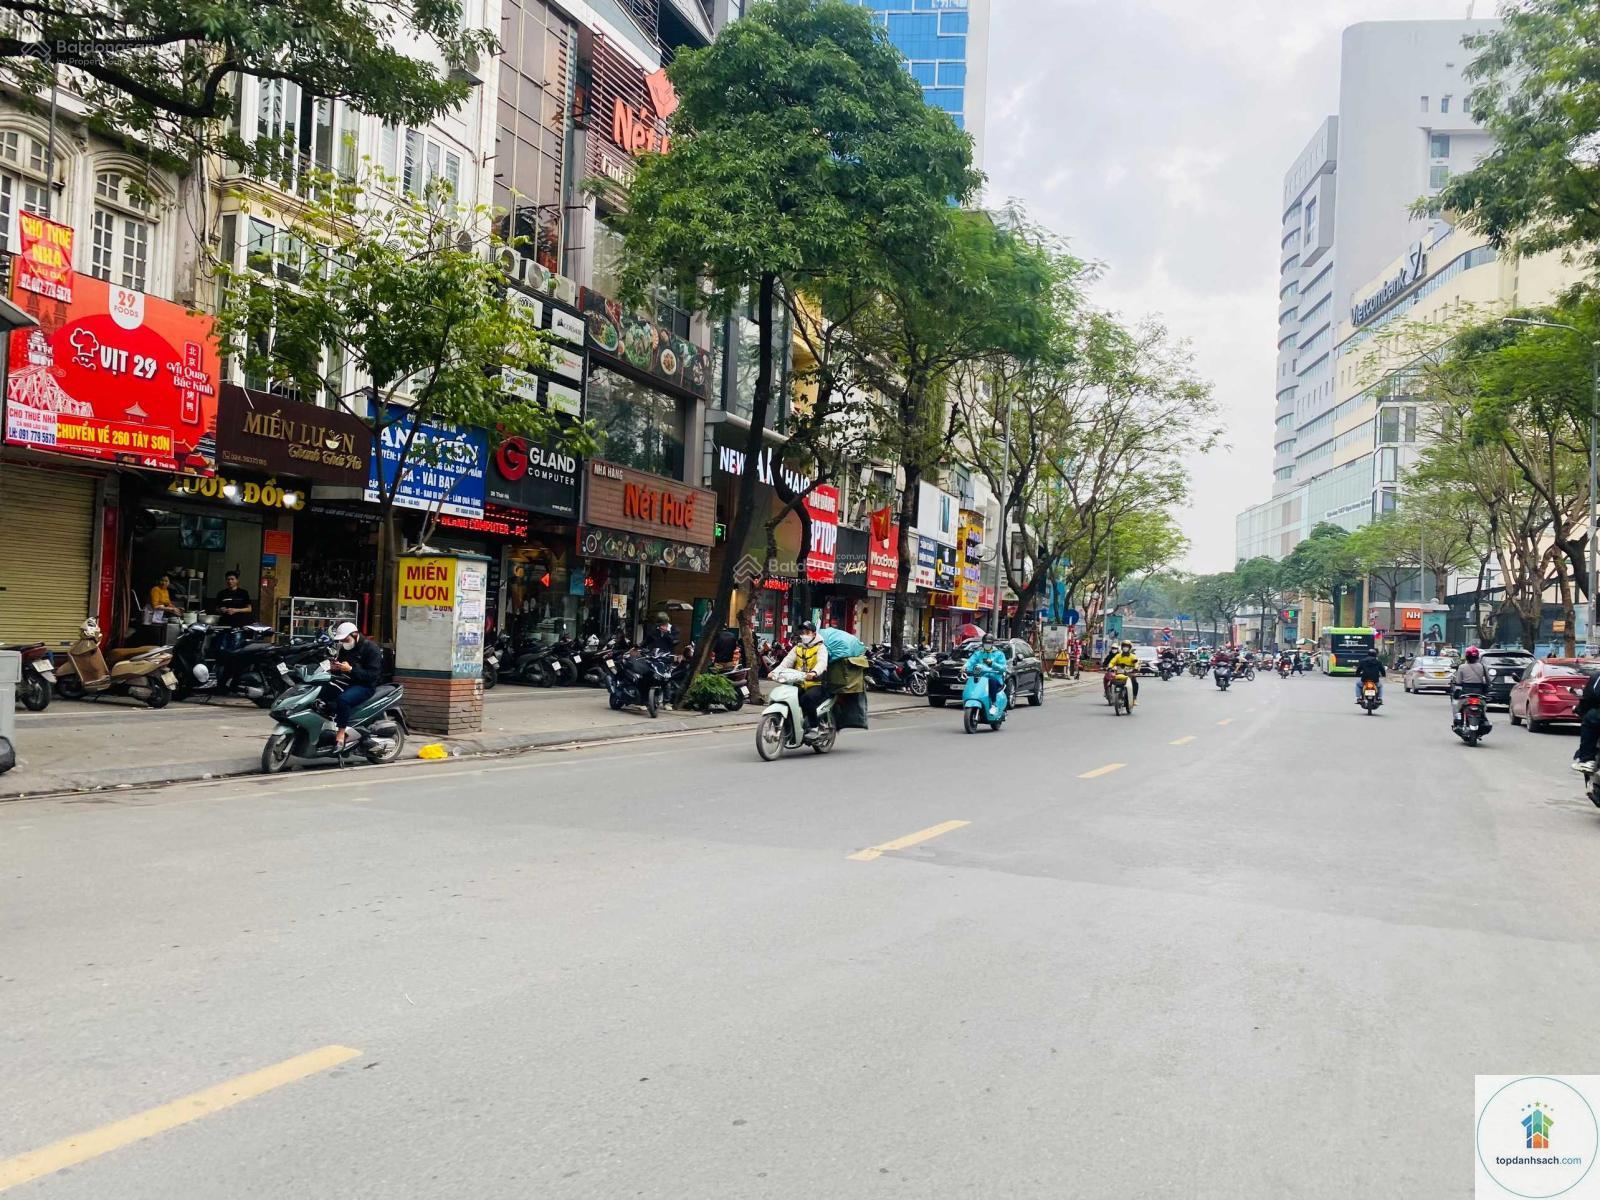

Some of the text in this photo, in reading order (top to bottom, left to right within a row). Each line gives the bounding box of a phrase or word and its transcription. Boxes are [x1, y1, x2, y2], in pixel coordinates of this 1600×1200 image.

[118, 290, 136, 308] 29
[1351, 267, 1408, 327] Vietcombank
[133, 354, 157, 379] 29
[184, 366, 208, 384] Quay
[193, 380, 214, 395] Kinh
[9, 407, 22, 418] CHO
[112, 430, 130, 446] 260
[132, 430, 149, 449] TÂY
[151, 434, 170, 451] SƠN
[144, 457, 157, 467] 44
[529, 447, 576, 474] GLAND
[720, 445, 747, 477] NEW
[528, 467, 576, 486] COMPUTER
[406, 559, 448, 581] MIẾN
[404, 585, 449, 601] LƯƠN
